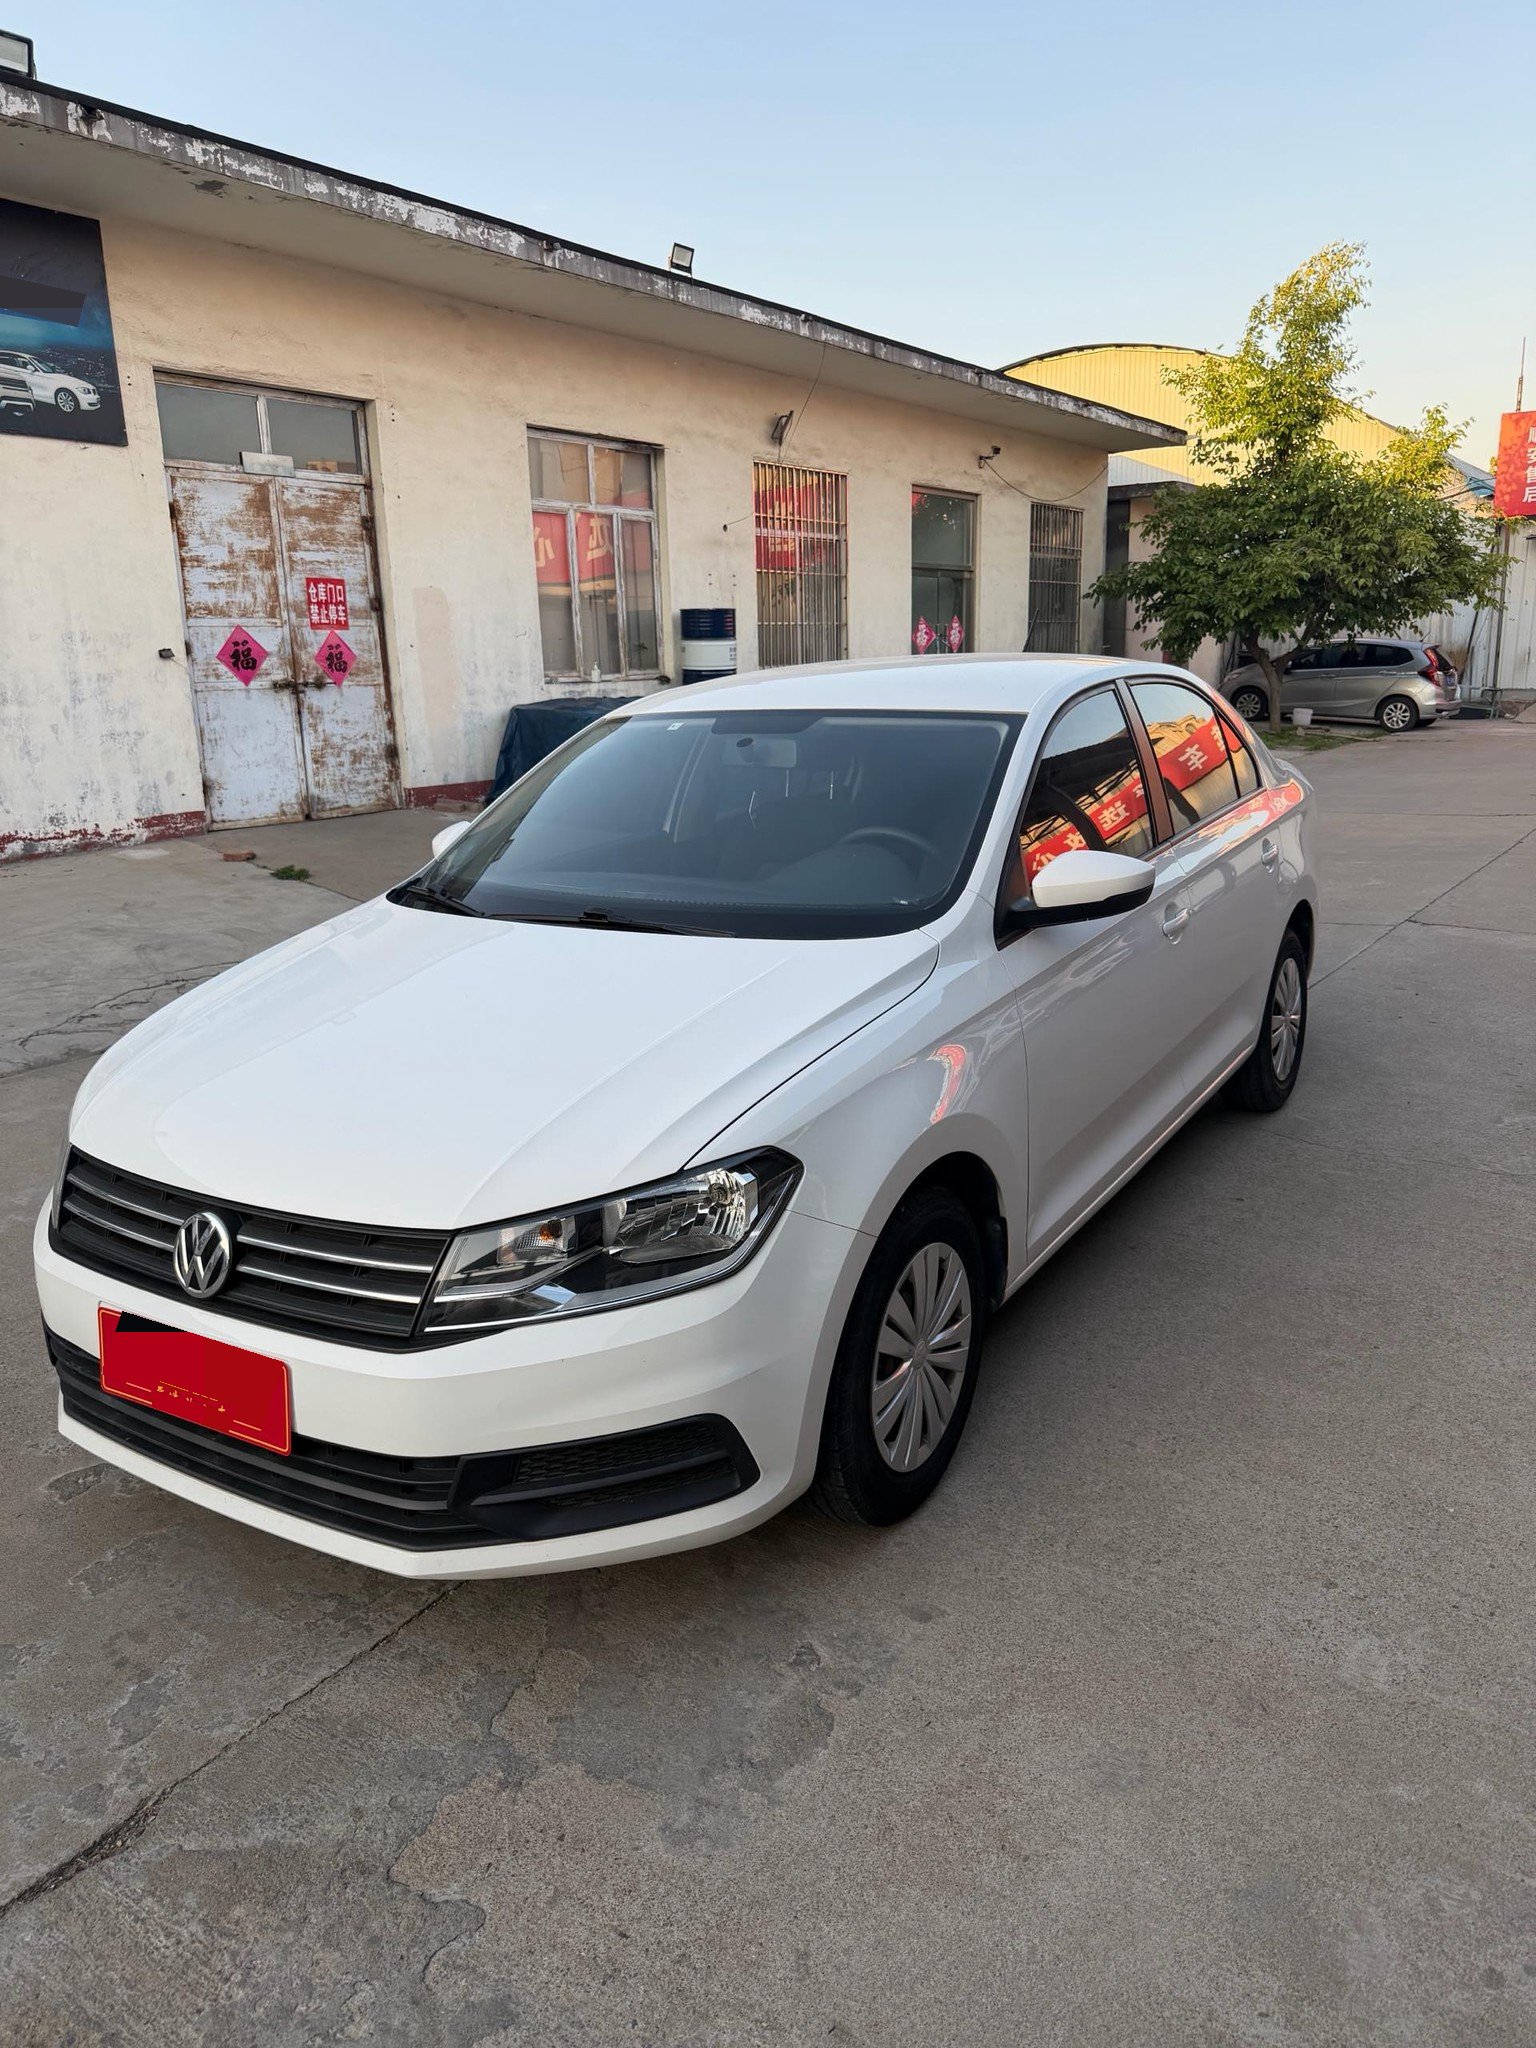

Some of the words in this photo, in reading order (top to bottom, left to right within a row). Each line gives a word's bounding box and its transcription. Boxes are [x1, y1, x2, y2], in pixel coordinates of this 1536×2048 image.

[308, 582, 345, 603] 仓库门口
[309, 604, 347, 625] 禁止停车
[229, 639, 258, 672] 福
[325, 643, 349, 673] 福
[173, 1212, 232, 1299] VW
